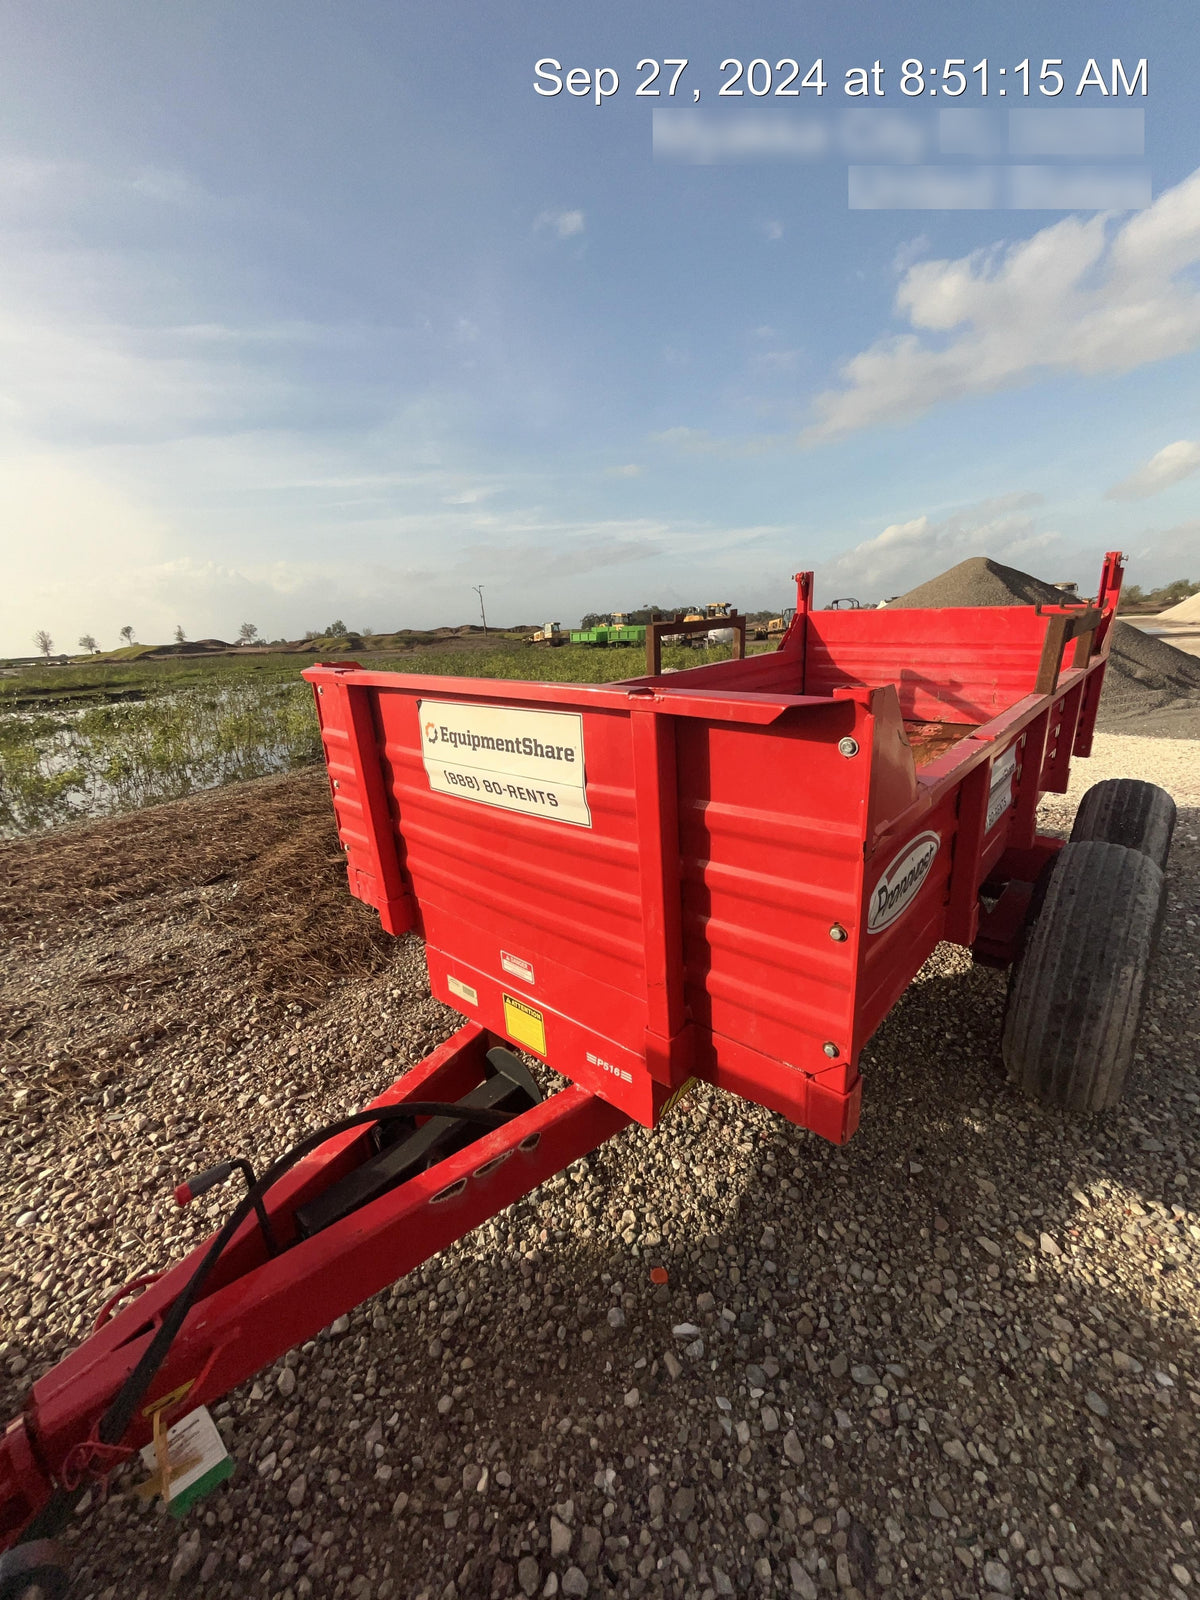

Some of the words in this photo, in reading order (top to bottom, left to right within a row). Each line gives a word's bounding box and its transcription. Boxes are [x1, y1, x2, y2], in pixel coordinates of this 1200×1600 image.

[440, 726, 575, 762] EquipmentShare
[443, 769, 480, 791] (888)
[483, 779, 559, 807] 80-RENTS
[511, 1000, 542, 1020] ATTENTION
[597, 1057, 621, 1077] P516
